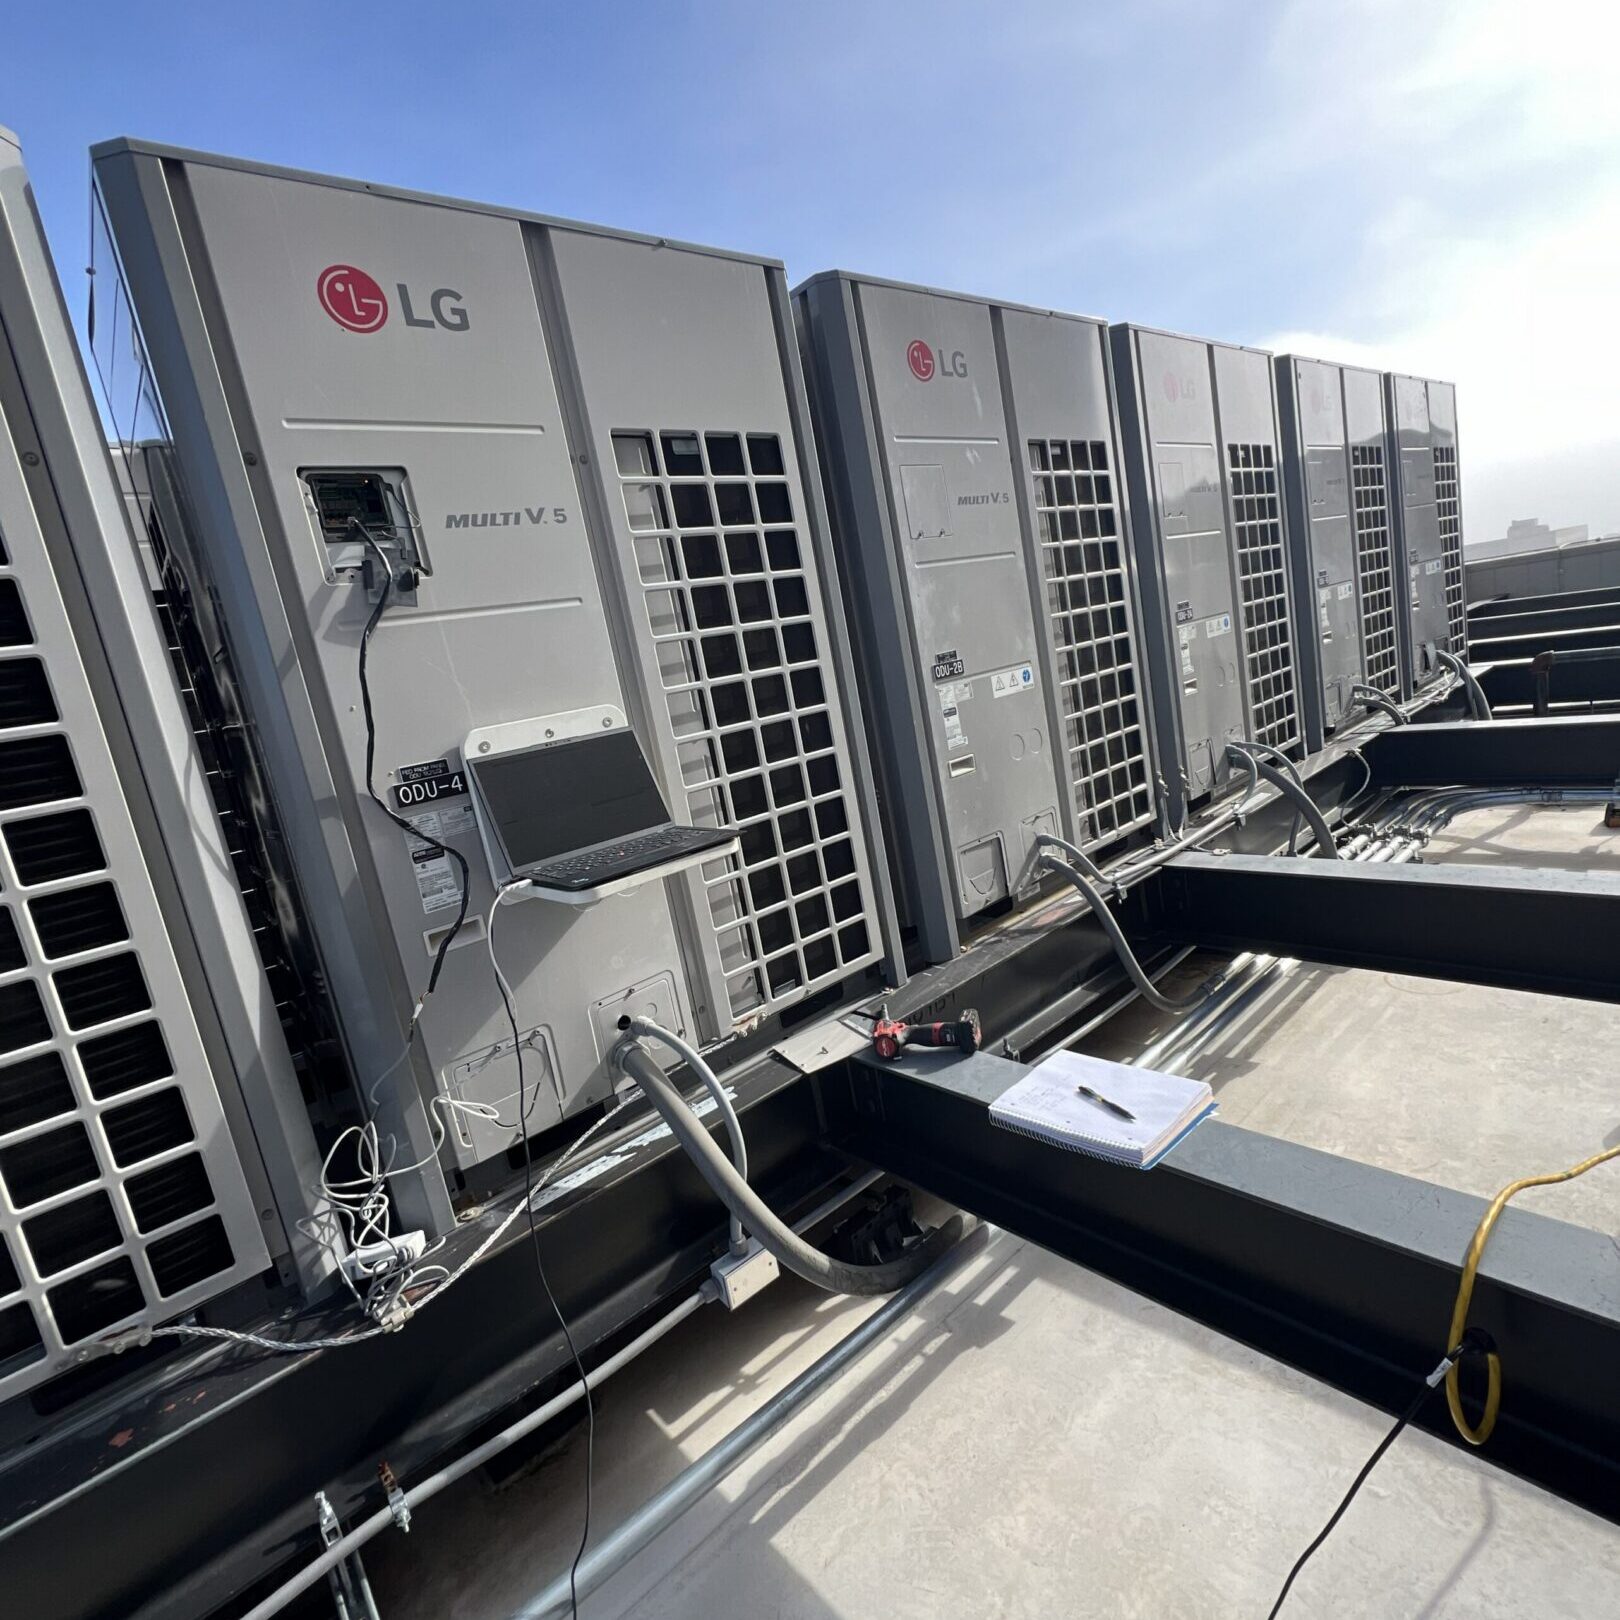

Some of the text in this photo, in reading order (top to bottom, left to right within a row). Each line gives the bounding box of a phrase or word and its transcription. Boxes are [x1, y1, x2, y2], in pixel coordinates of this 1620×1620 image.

[396, 283, 470, 332] LG
[938, 349, 968, 378] LG
[957, 494, 989, 506] MULTI
[445, 512, 521, 529] MULTI
[553, 508, 567, 524] 5
[399, 775, 464, 804] ODU-4
